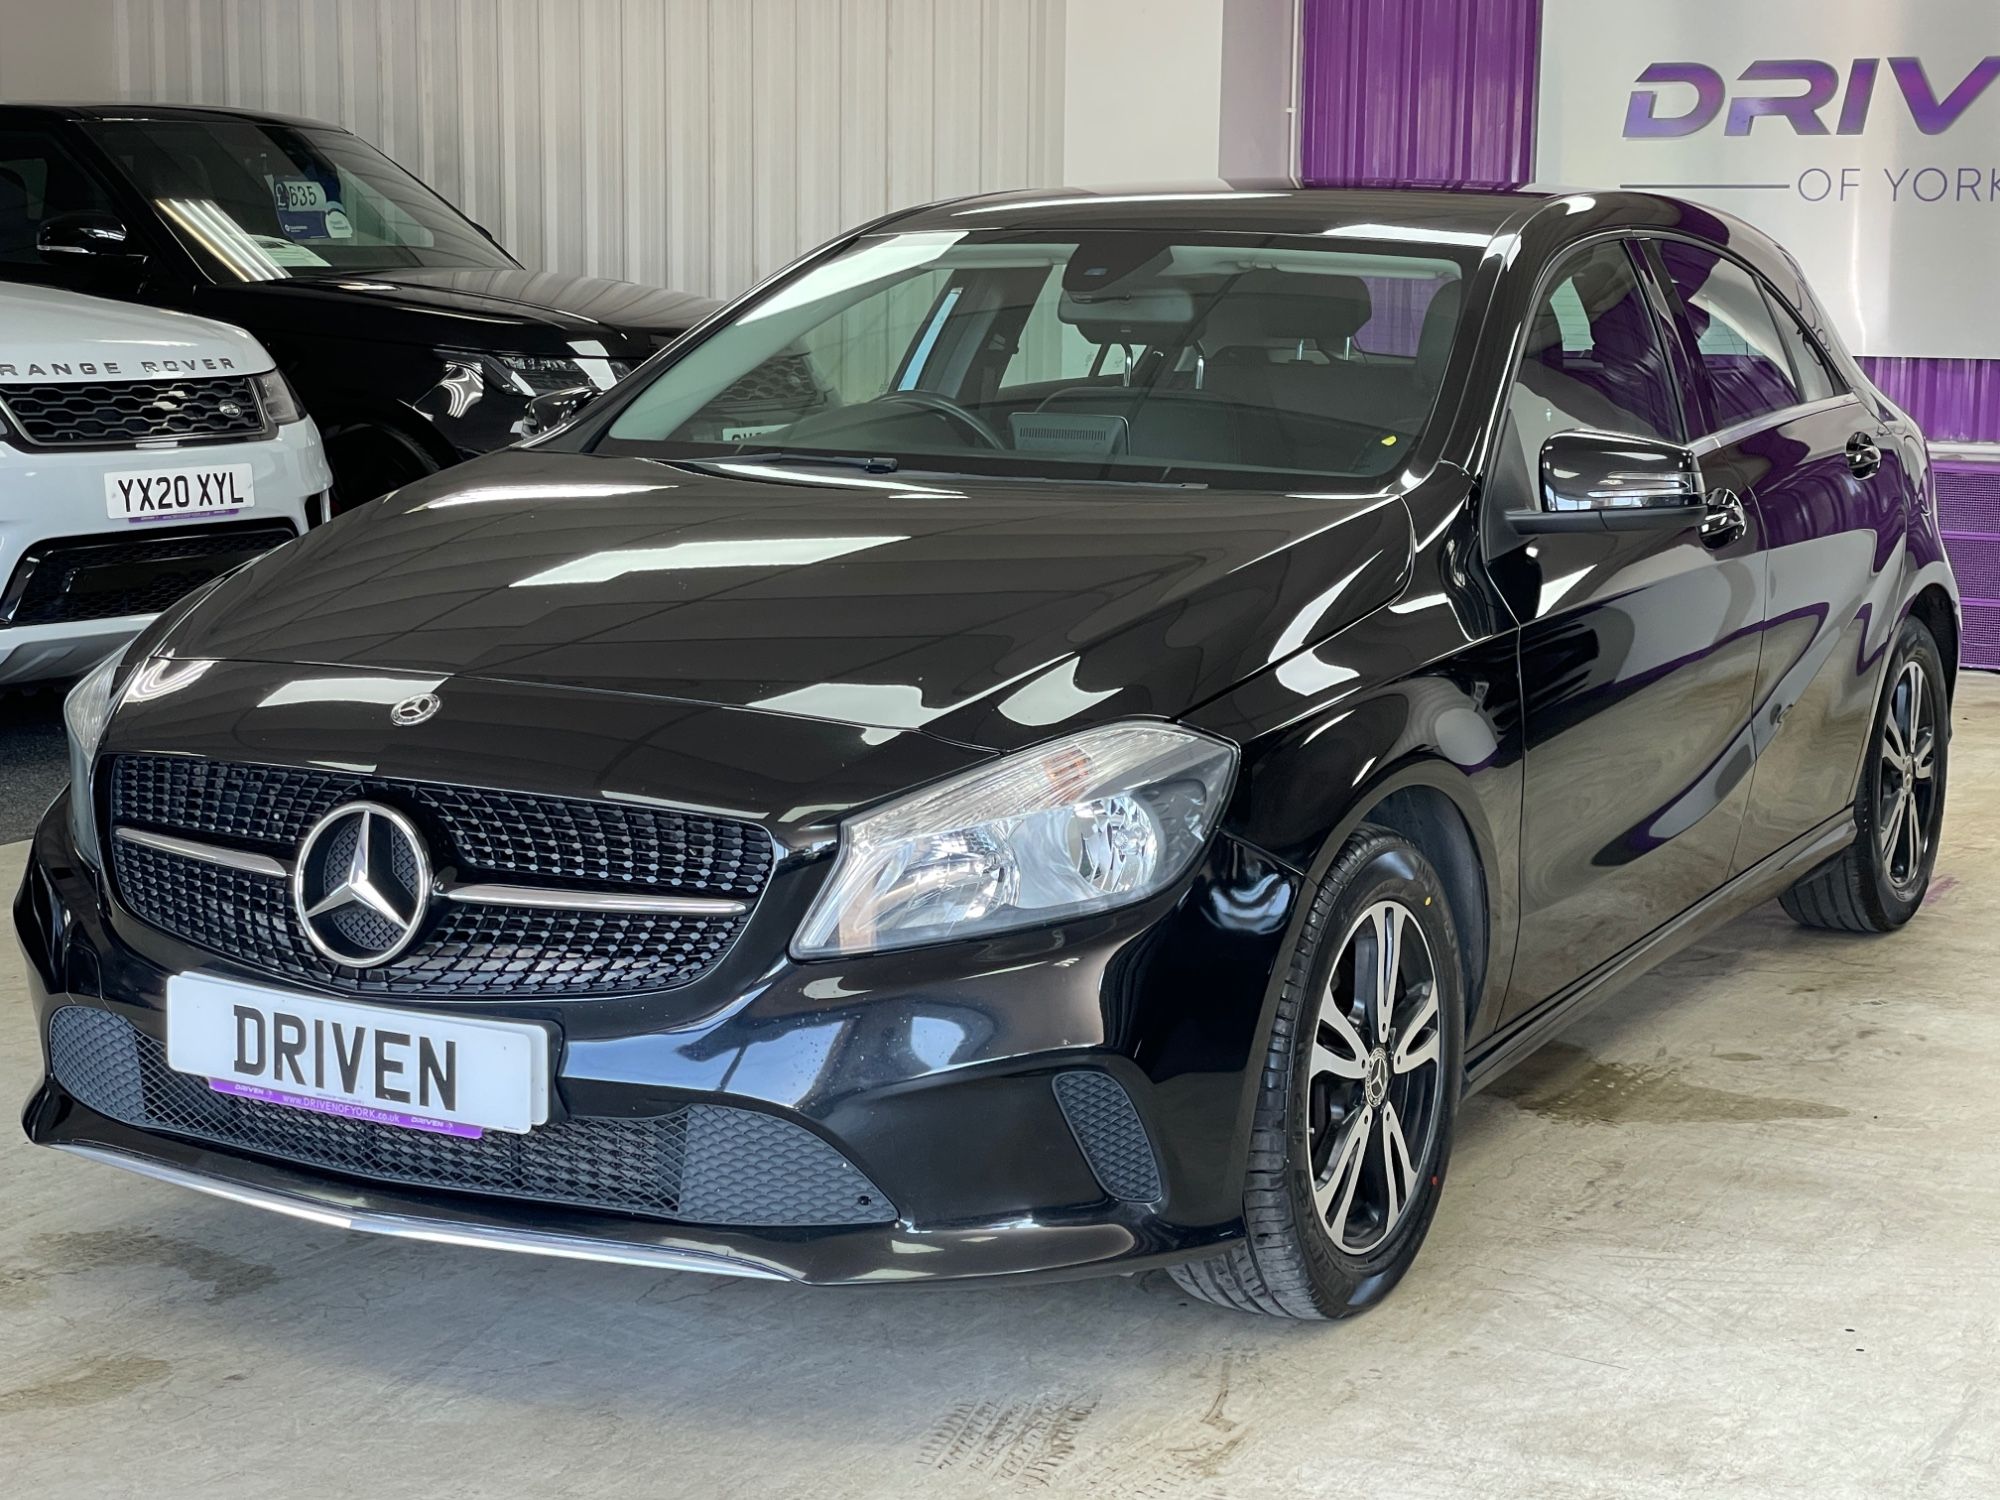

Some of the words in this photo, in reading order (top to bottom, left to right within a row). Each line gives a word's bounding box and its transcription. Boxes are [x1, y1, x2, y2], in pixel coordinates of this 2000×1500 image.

[1622, 56, 2000, 138] DRIV
[1798, 168, 1861, 202] OF
[0, 362, 121, 376] RANGE
[141, 358, 235, 372] ROVER
[117, 475, 190, 512] YX20
[198, 471, 244, 506] XYL
[233, 1004, 456, 1112] DRIVEN
[234, 1084, 264, 1096] DRIVEN
[281, 1094, 400, 1123] www.DRIVENOFYORK.co.uk
[410, 1116, 444, 1128] DRIVEN
